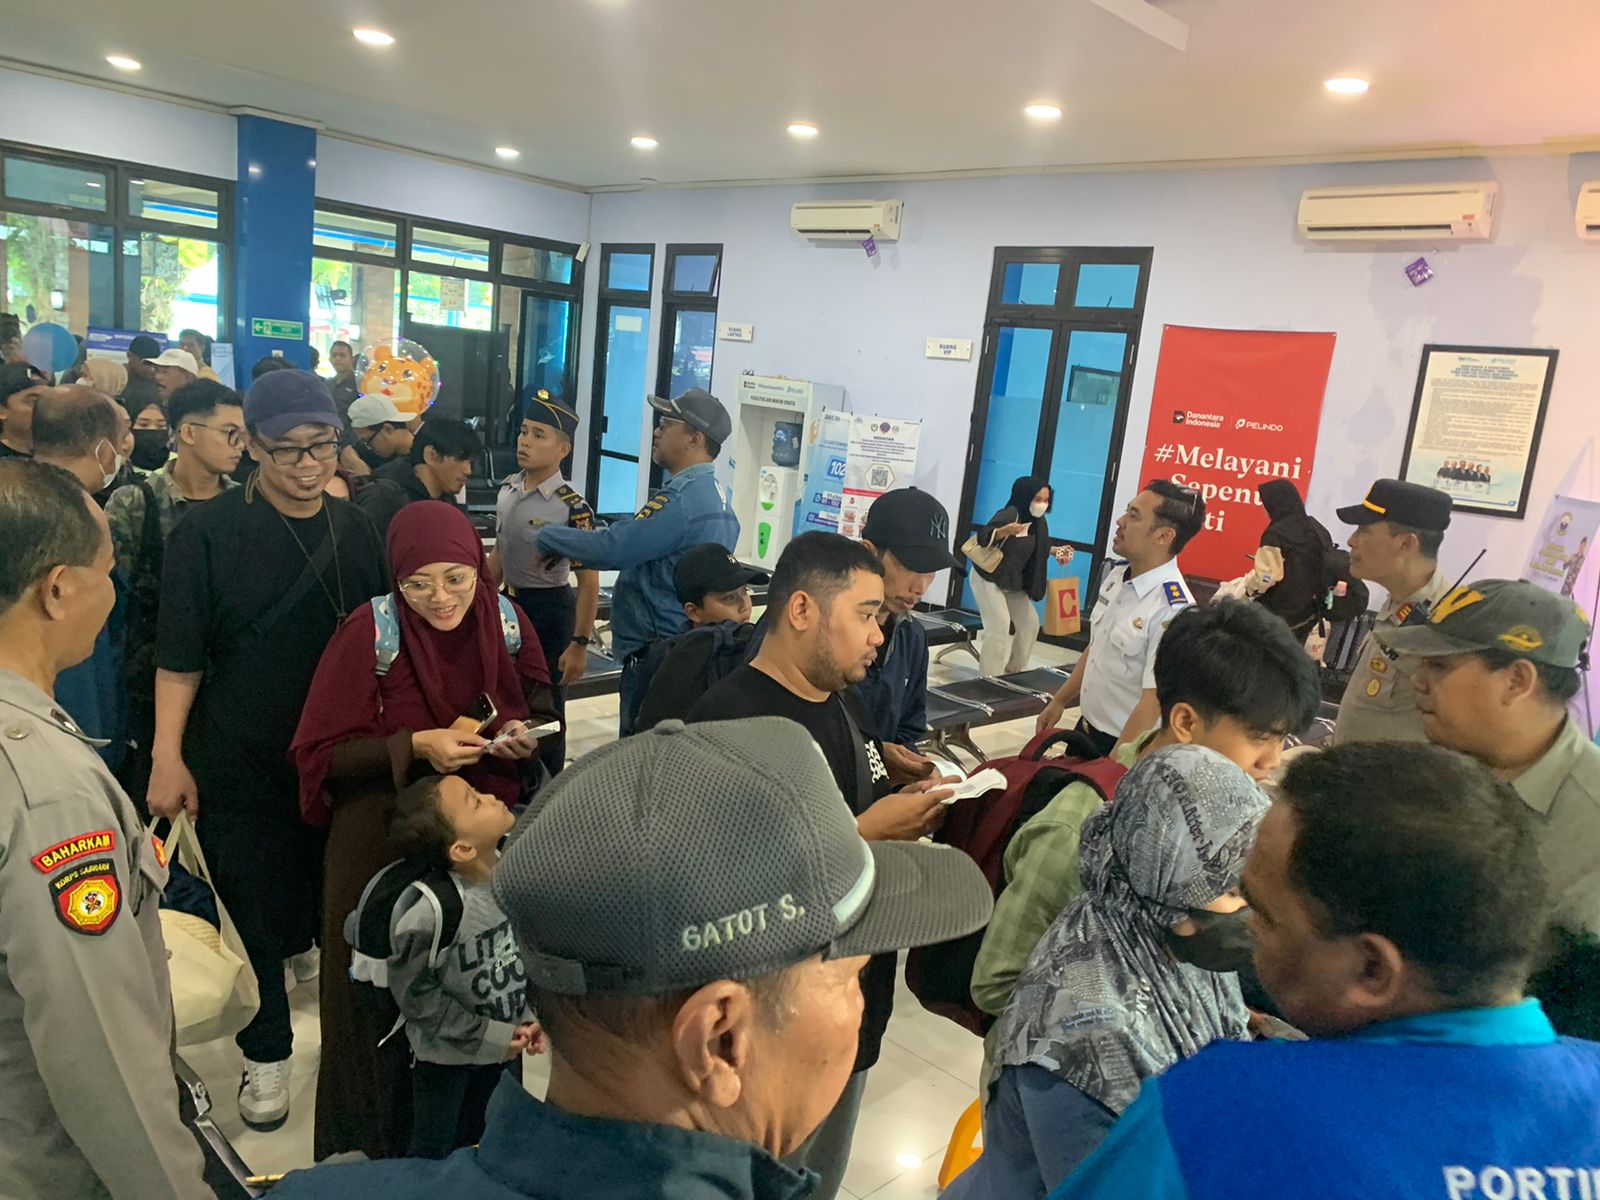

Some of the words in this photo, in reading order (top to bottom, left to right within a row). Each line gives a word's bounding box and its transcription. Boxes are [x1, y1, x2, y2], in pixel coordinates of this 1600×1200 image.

[1185, 419, 1221, 429] Indonesia
[1186, 411, 1224, 421] Danantara
[1246, 421, 1284, 432] PELINDO
[1154, 443, 1303, 479] #Melayani
[41, 834, 109, 867] BAHARKAM
[55, 872, 79, 889] KORPS
[681, 902, 769, 951] GATOT
[779, 892, 806, 921] S.
[471, 952, 528, 1000] COO
